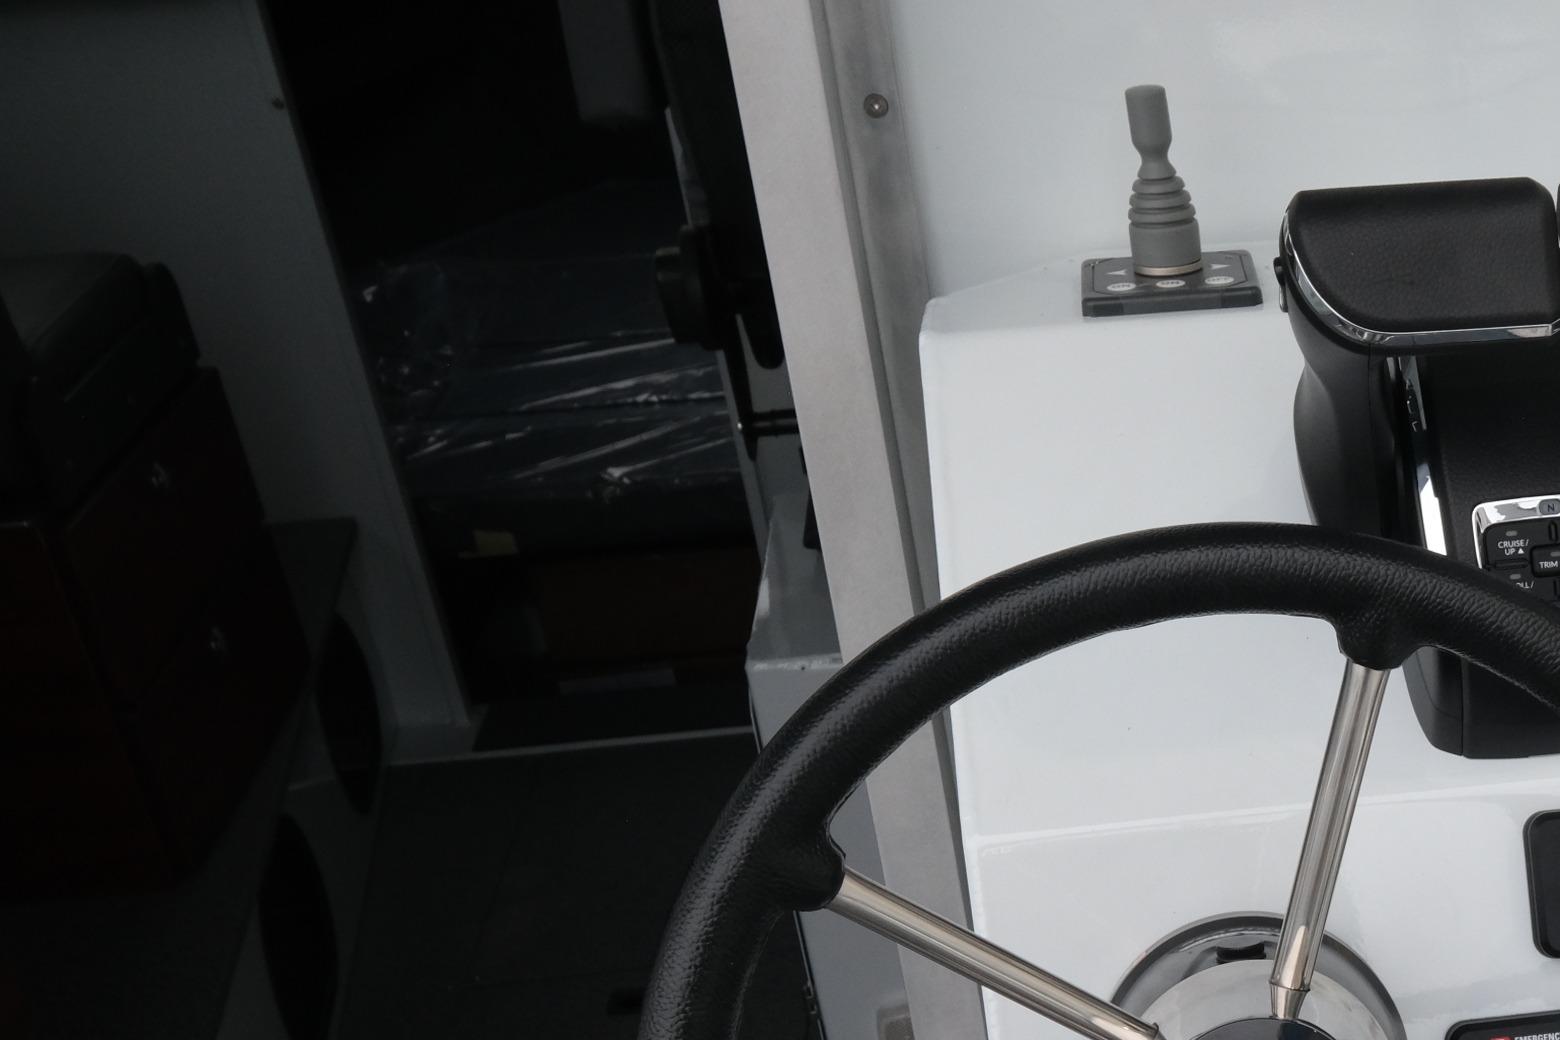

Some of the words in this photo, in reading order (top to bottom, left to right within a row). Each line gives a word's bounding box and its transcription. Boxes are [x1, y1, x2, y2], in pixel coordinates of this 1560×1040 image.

[1498, 539, 1529, 549] CRUISE/
[1504, 548, 1516, 556] UP
[1539, 561, 1559, 569] TRIM
